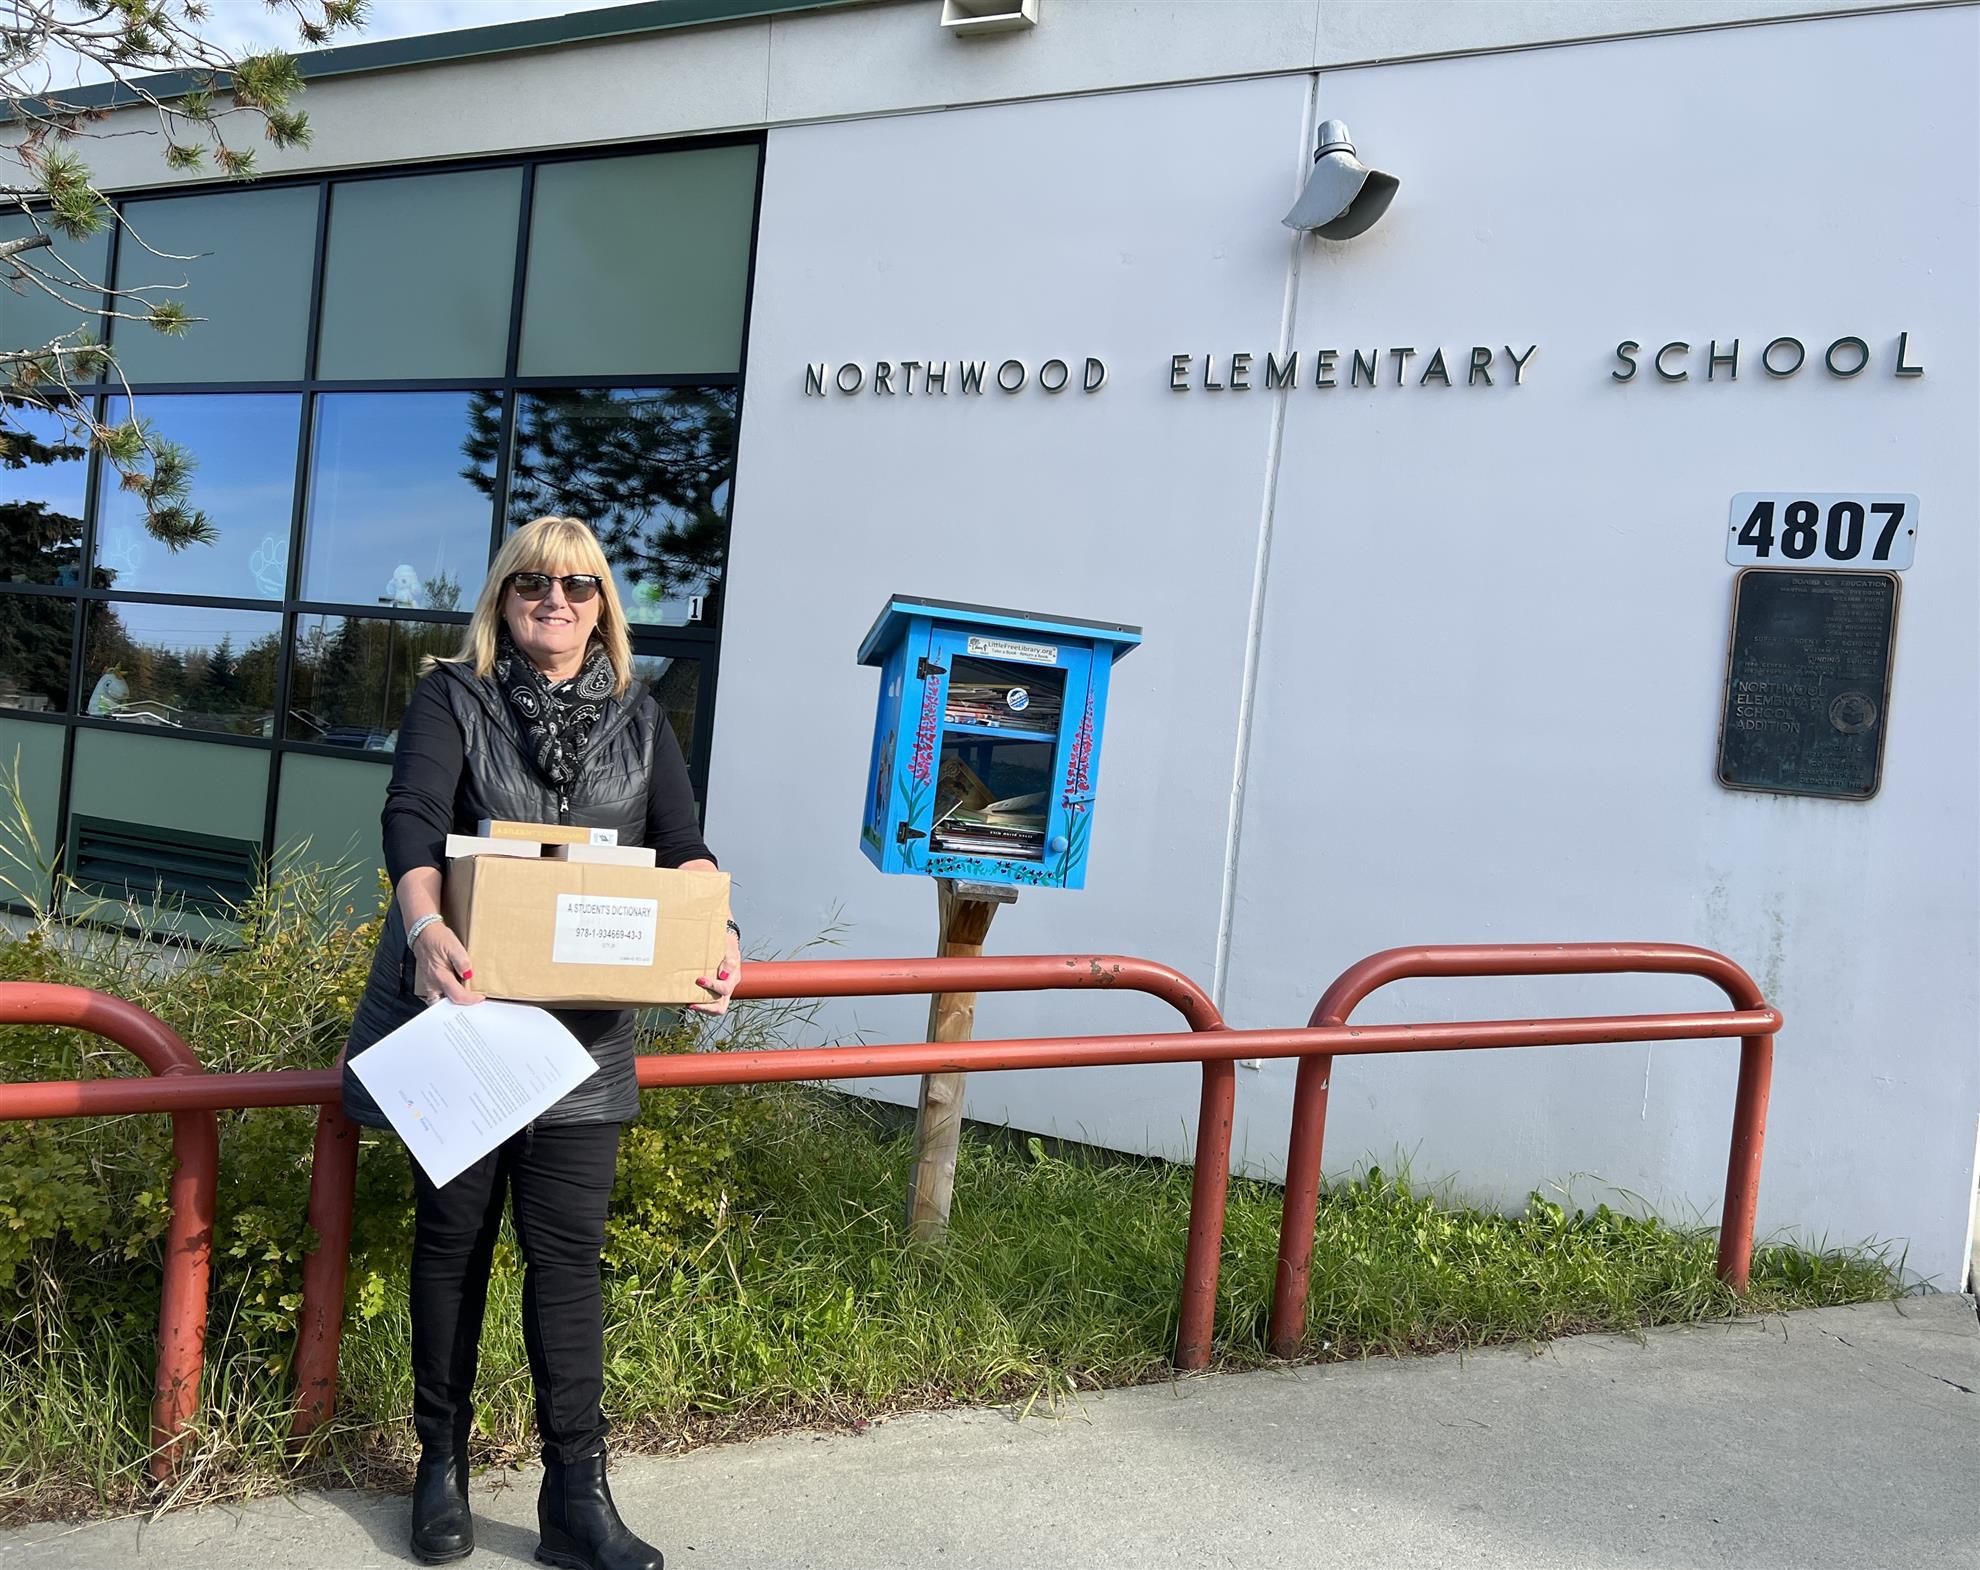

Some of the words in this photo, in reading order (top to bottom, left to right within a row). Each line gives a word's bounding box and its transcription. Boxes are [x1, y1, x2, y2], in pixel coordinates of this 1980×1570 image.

[804, 356, 1109, 397] NORTHWOOD
[1169, 344, 1539, 391] ELEMENTARY
[1611, 331, 1925, 383] SCHOOL
[1737, 500, 1906, 561] 4807
[690, 597, 698, 619] 1
[988, 641, 1053, 656] LittleFreeLibrary.org
[1739, 681, 1828, 697] NORTHWOOD
[1737, 694, 1824, 709] ELEMENTARY
[1736, 706, 1795, 720] SCHOOL
[1736, 719, 1801, 733] ADDITION
[567, 903, 573, 913] A
[574, 903, 611, 916] STUDENT'S
[611, 905, 652, 918] DICTIONARY
[575, 927, 643, 940] 978-1-934669-43-3
